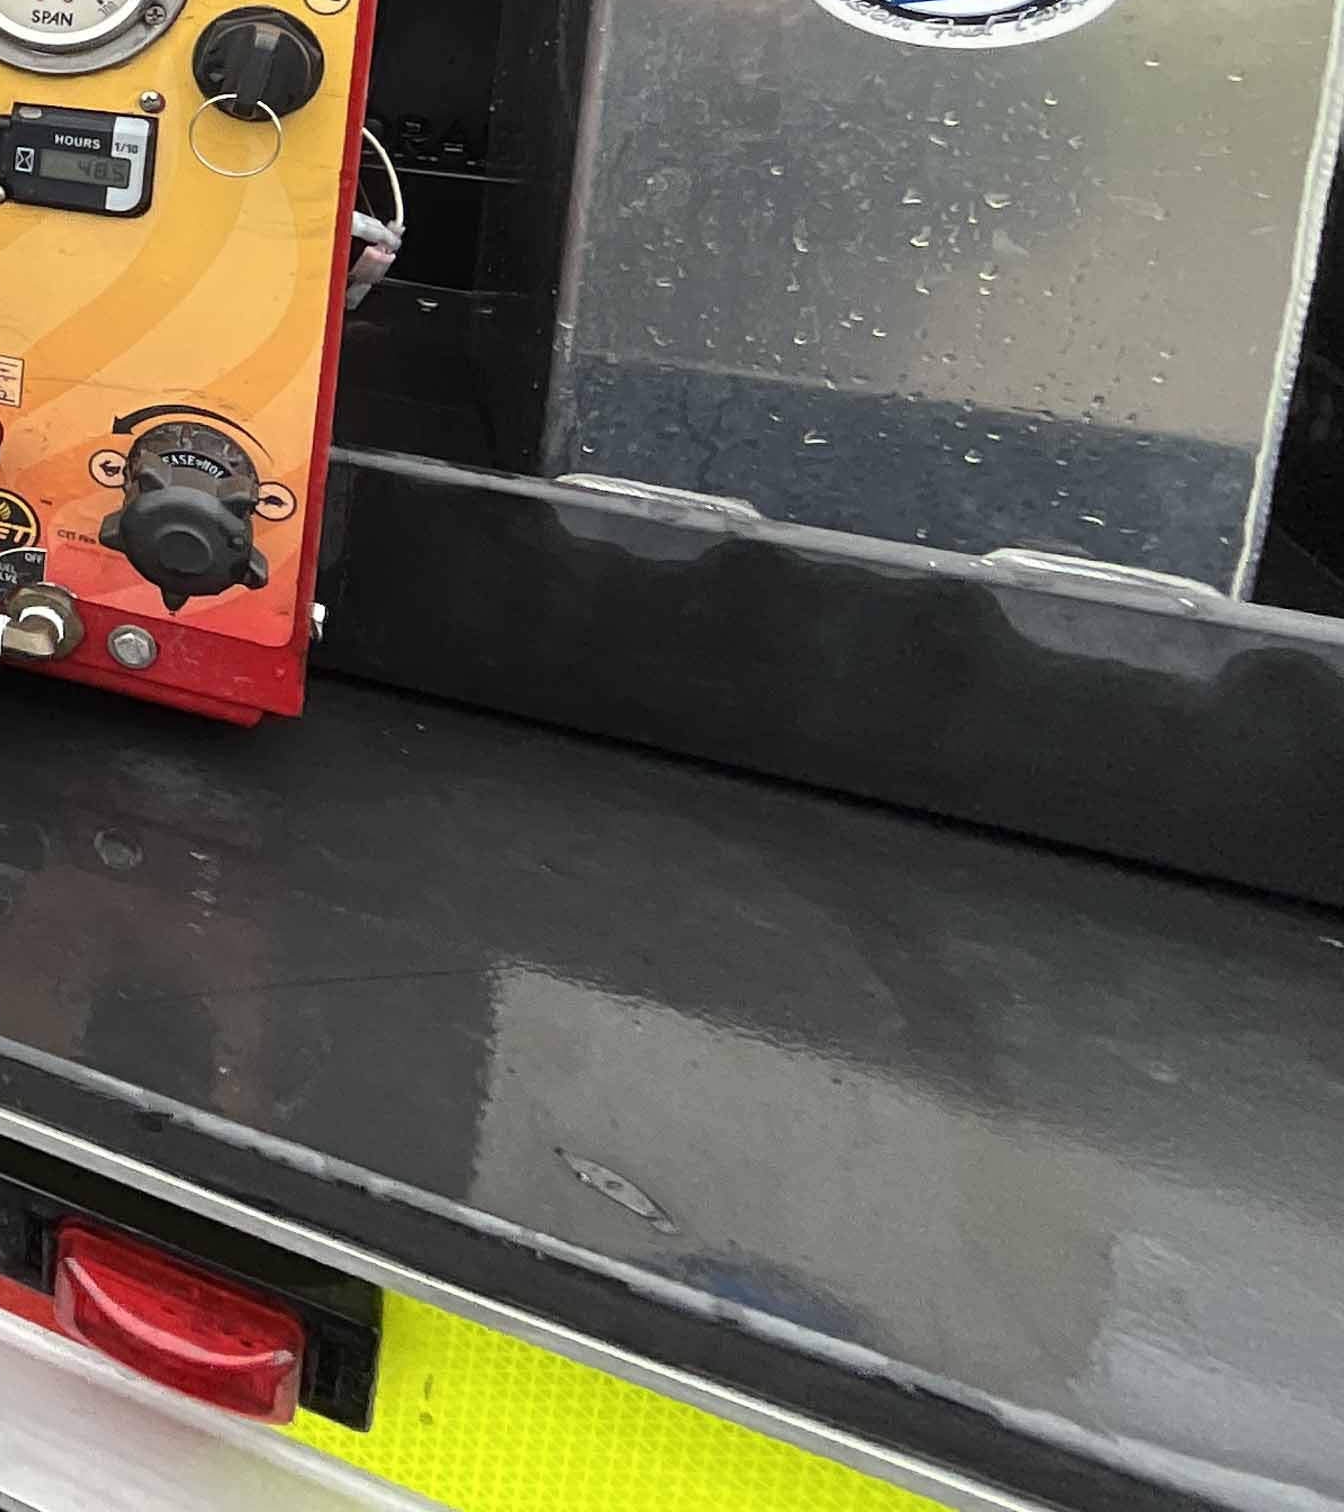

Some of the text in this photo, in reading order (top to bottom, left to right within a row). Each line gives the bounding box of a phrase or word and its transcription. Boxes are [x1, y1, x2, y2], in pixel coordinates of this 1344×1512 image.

[31, 9, 74, 27] SPAN
[54, 133, 101, 150] HOURS
[24, 552, 43, 564] OFF
